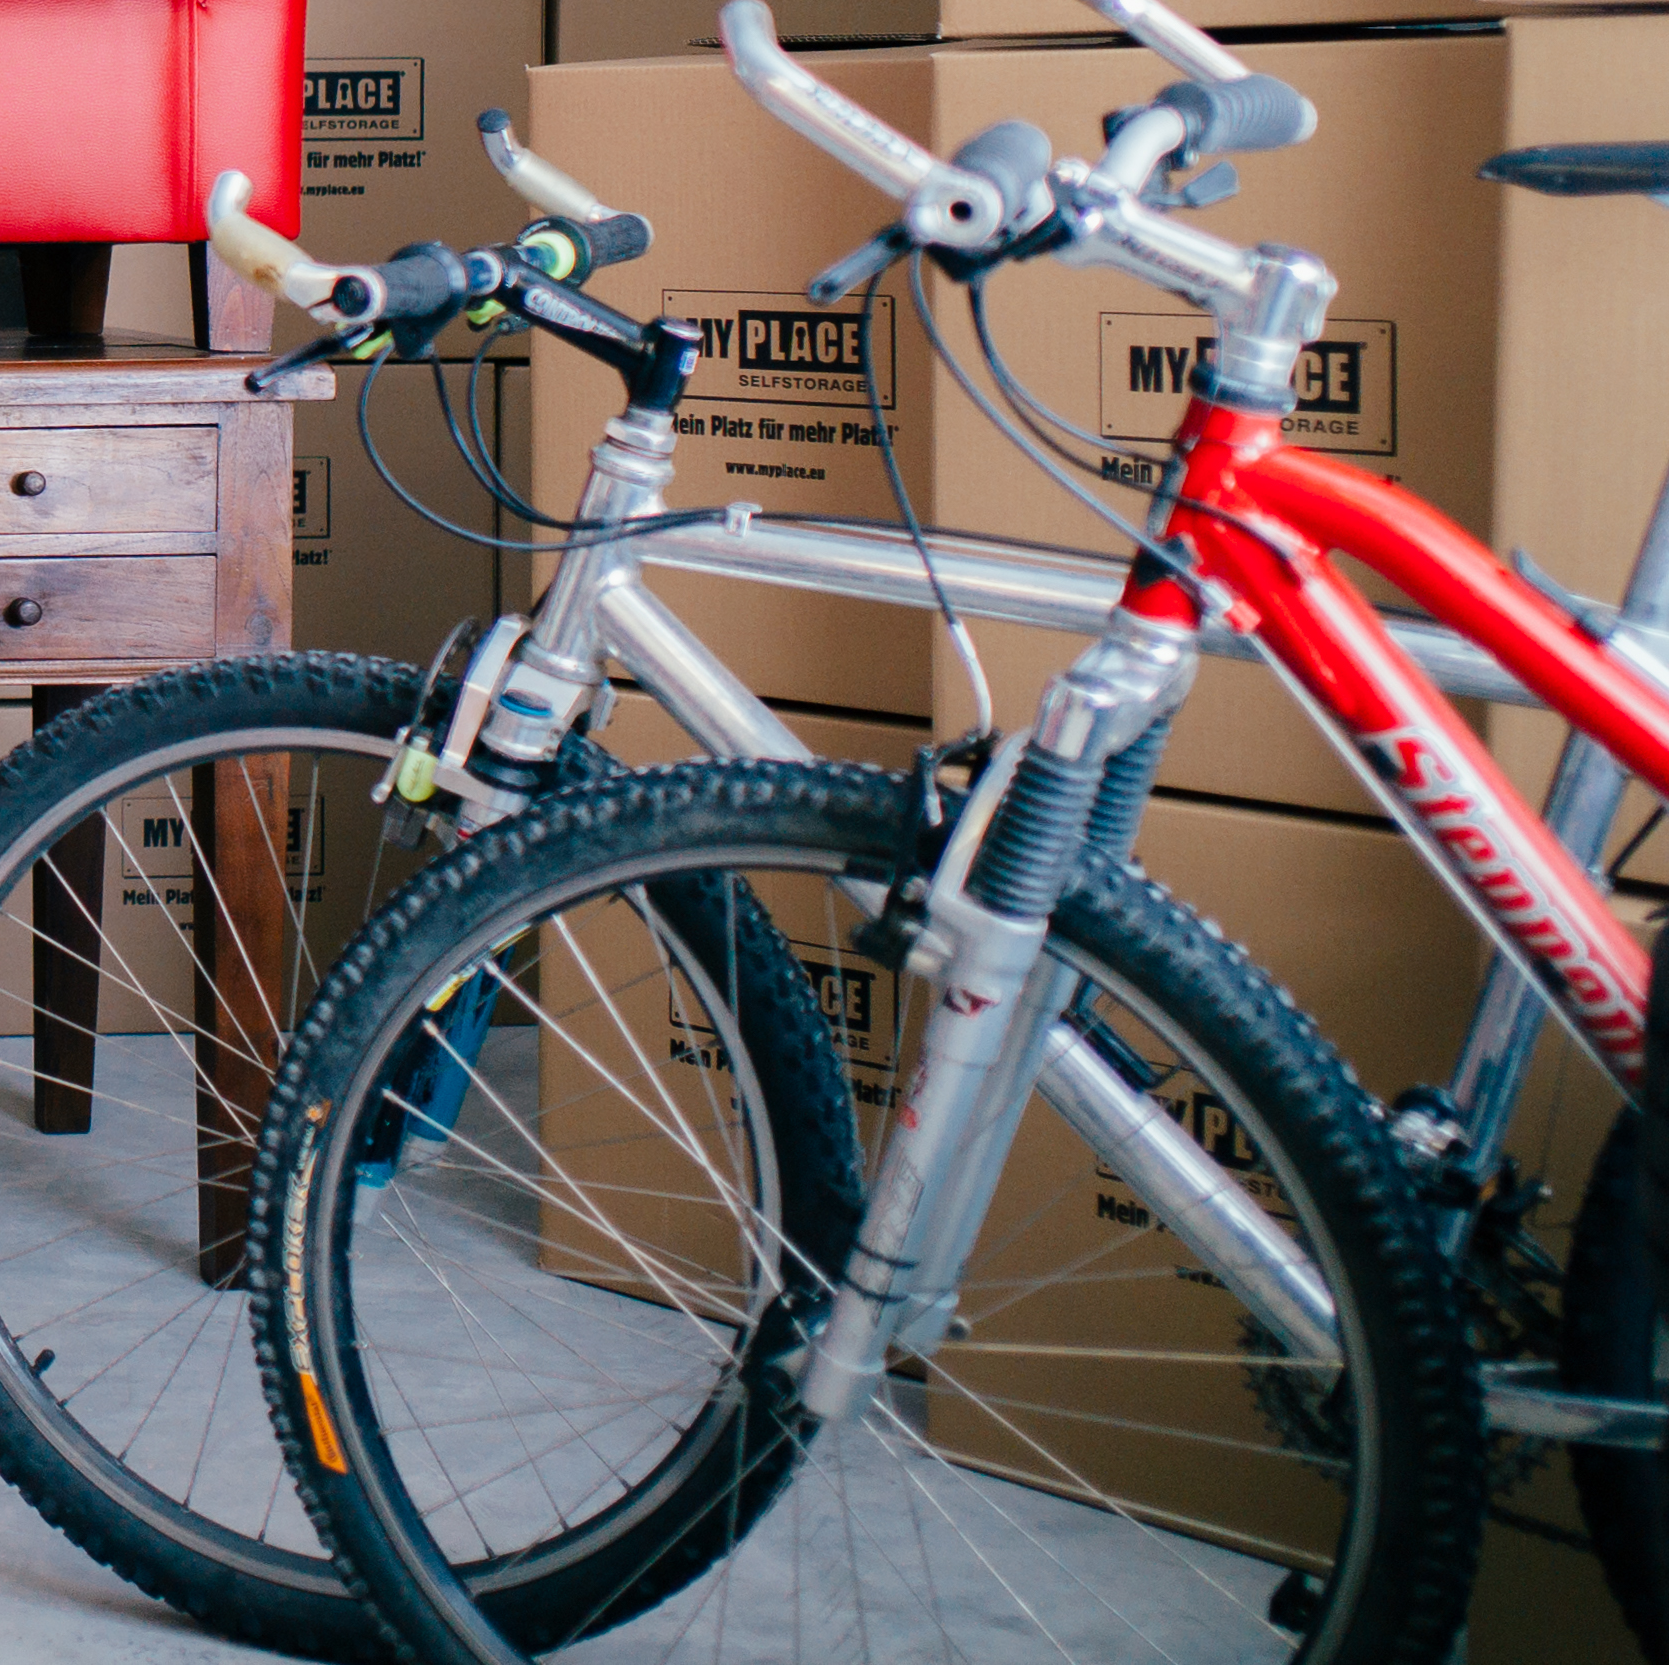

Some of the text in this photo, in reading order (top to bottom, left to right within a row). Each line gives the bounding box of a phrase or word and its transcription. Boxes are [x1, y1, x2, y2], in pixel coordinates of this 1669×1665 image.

[307, 150, 422, 168] für mehr Platz!
[746, 319, 861, 364] PLACE
[738, 374, 868, 393] SELFSTORAGE
[1129, 345, 1191, 394] MY
[711, 415, 753, 439] Platz
[759, 417, 784, 439] für
[789, 420, 837, 443] mehr
[1101, 456, 1153, 484] Mein
[143, 817, 185, 848] MY
[1097, 1193, 1150, 1229] Mein
